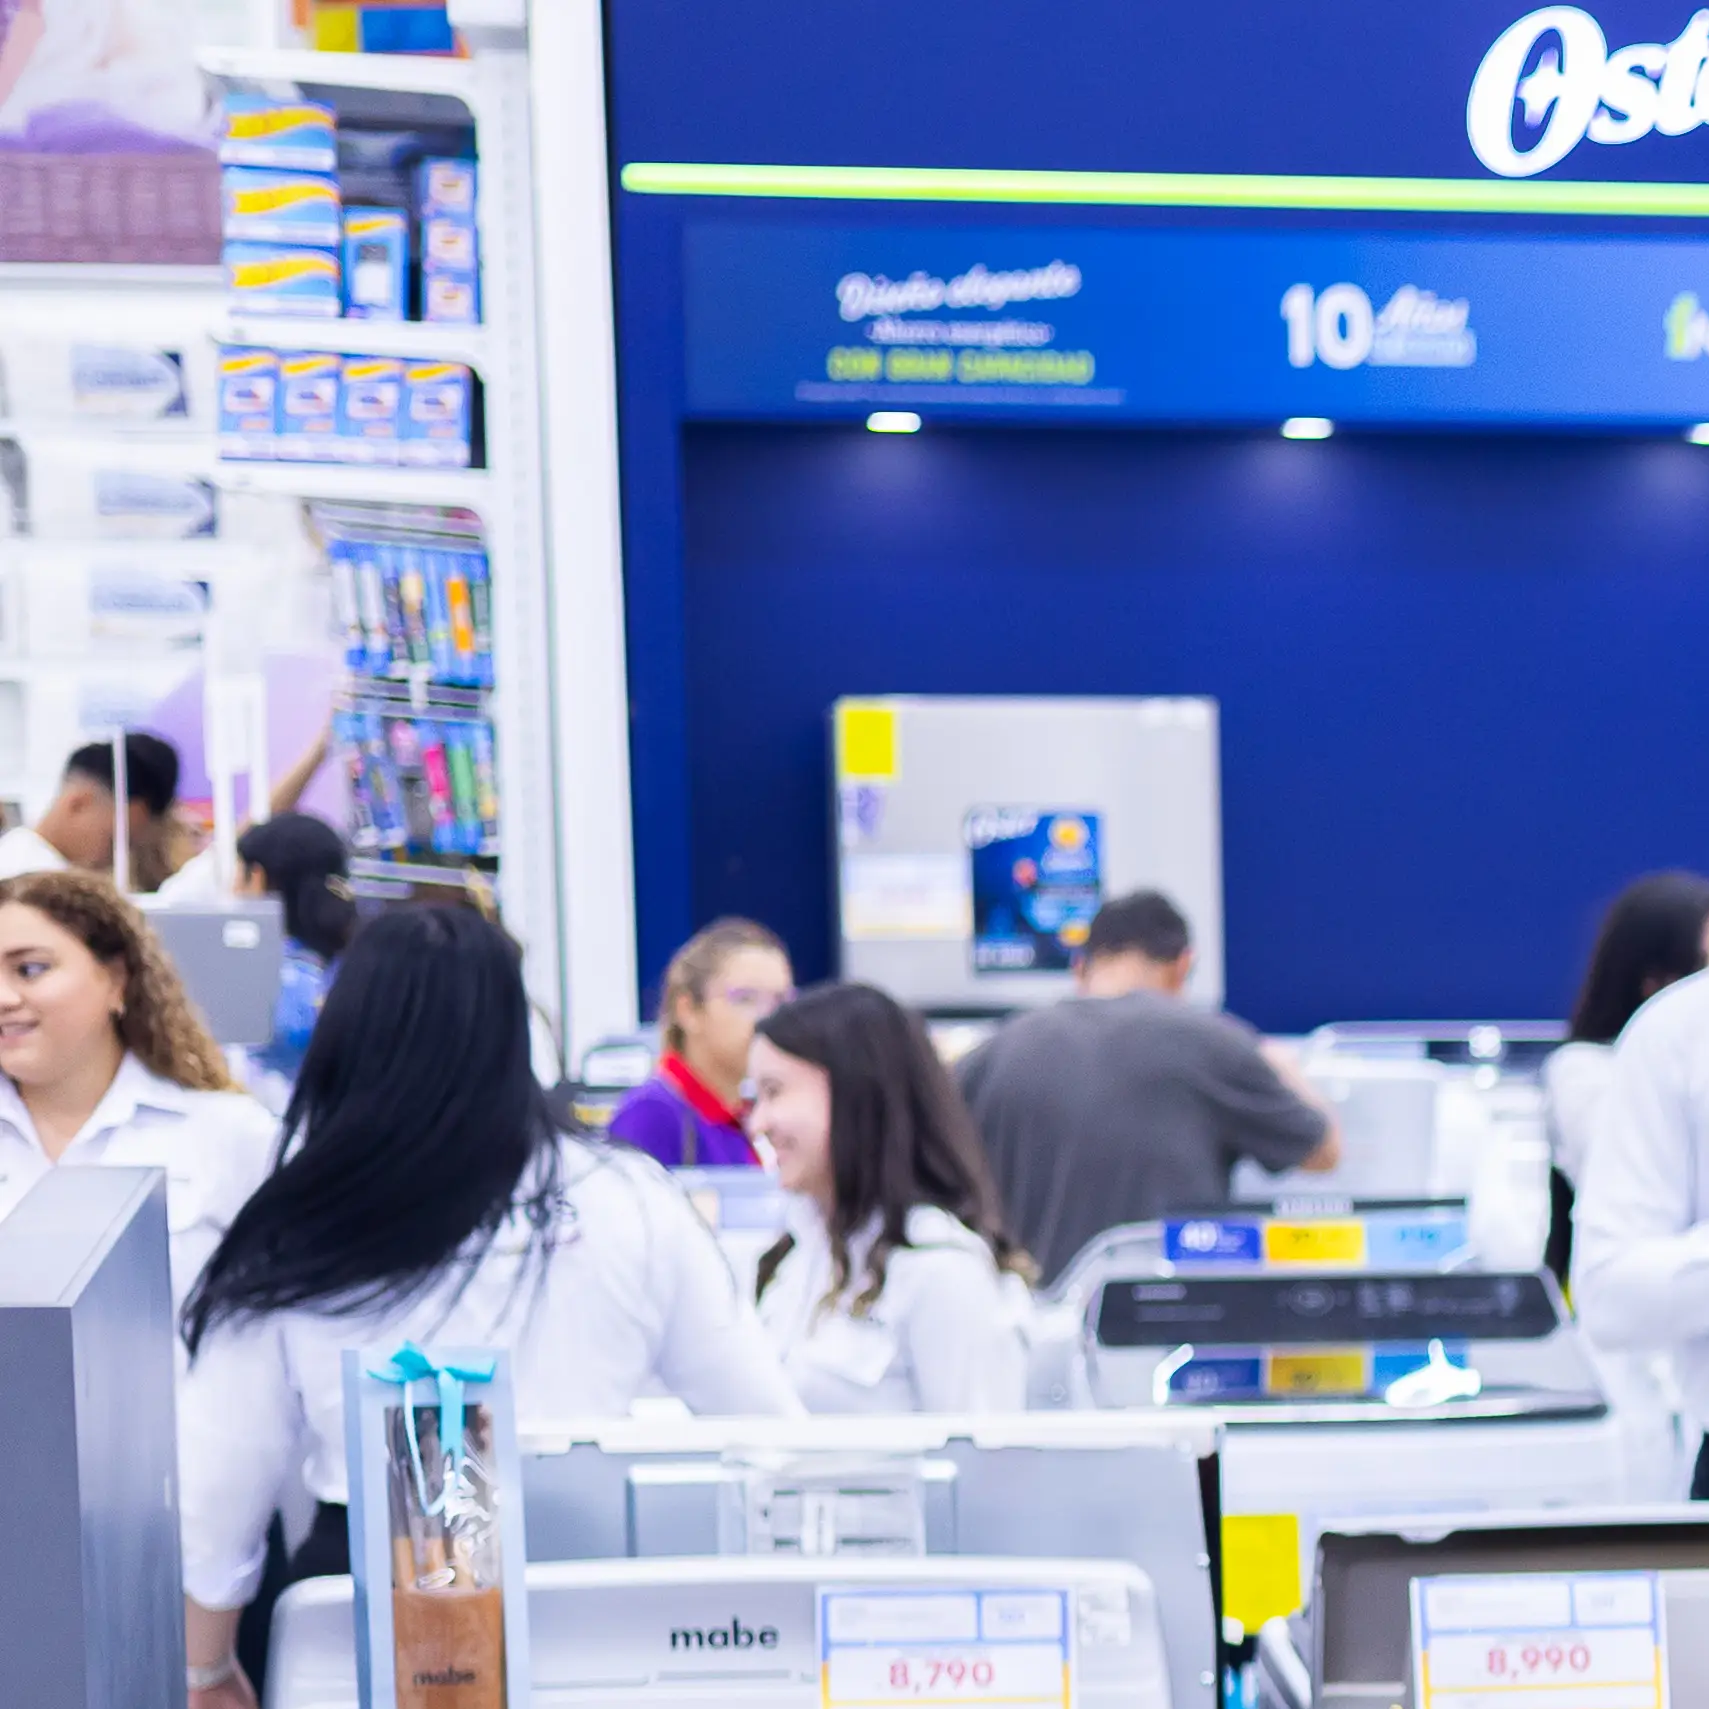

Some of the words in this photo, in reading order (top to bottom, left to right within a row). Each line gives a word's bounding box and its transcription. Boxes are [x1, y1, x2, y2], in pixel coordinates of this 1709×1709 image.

[1281, 282, 1374, 370] 10
[669, 1616, 780, 1652] mabe
[413, 1666, 478, 1690] mabe
[889, 1660, 995, 1695] 8,790
[1487, 1644, 1592, 1680] 8,990
